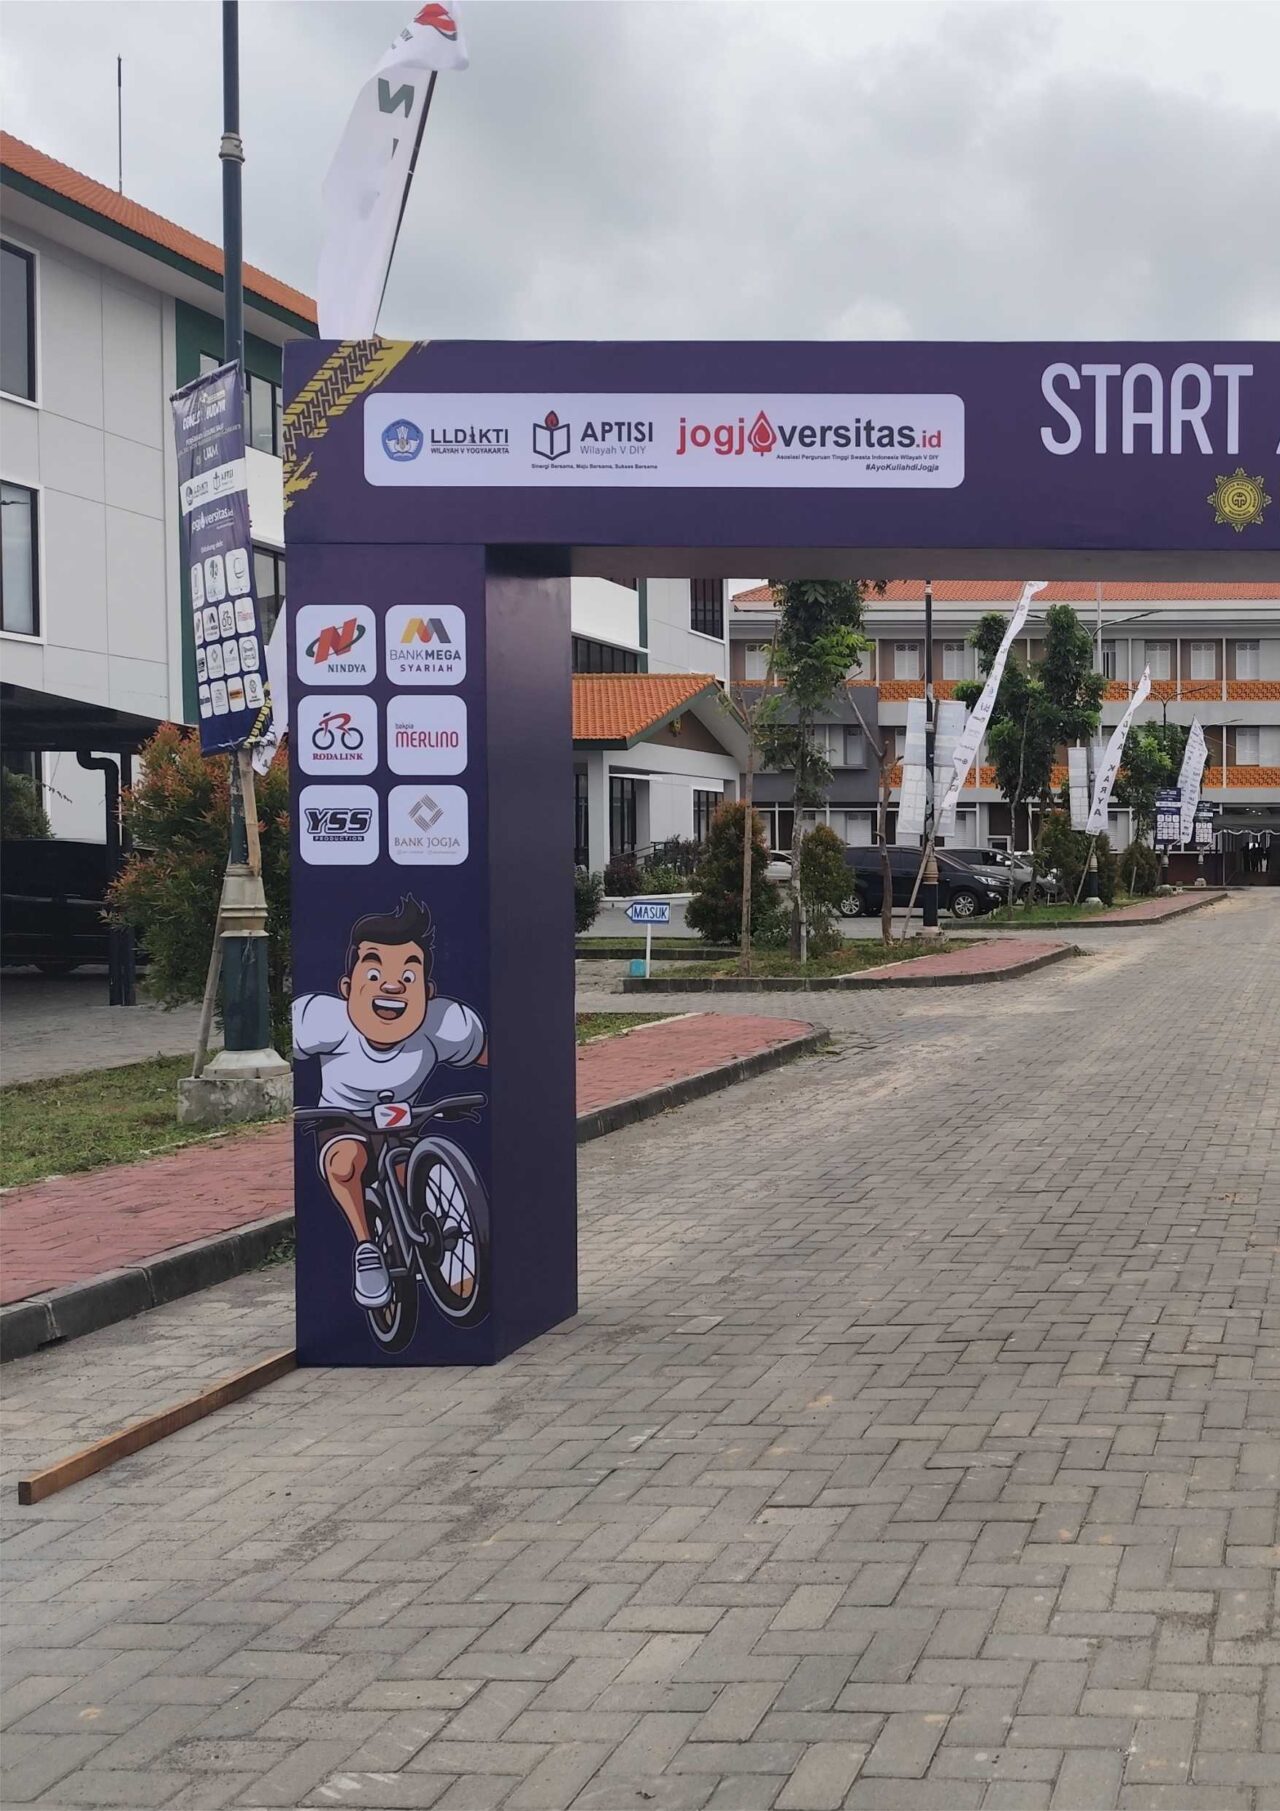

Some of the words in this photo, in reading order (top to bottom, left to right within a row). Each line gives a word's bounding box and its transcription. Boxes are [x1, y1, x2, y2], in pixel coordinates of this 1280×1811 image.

[1040, 362, 1254, 455] START
[430, 426, 509, 444] LLDIKTI
[580, 421, 654, 442] APTISI
[430, 447, 459, 455] WILAYAH
[580, 445, 617, 455] Wilayah
[619, 446, 627, 454] V
[629, 446, 646, 454] DIY
[865, 463, 940, 473] #AyoKuliahdiJogja
[327, 663, 366, 673] NINDYA
[399, 664, 453, 672] SYARIAH
[395, 731, 459, 748] MERLINO
[312, 752, 364, 761] RODALINK
[305, 808, 372, 834] YSS
[394, 837, 423, 846] BANK
[427, 837, 460, 848] JOGJA
[634, 905, 667, 919] MASUK
